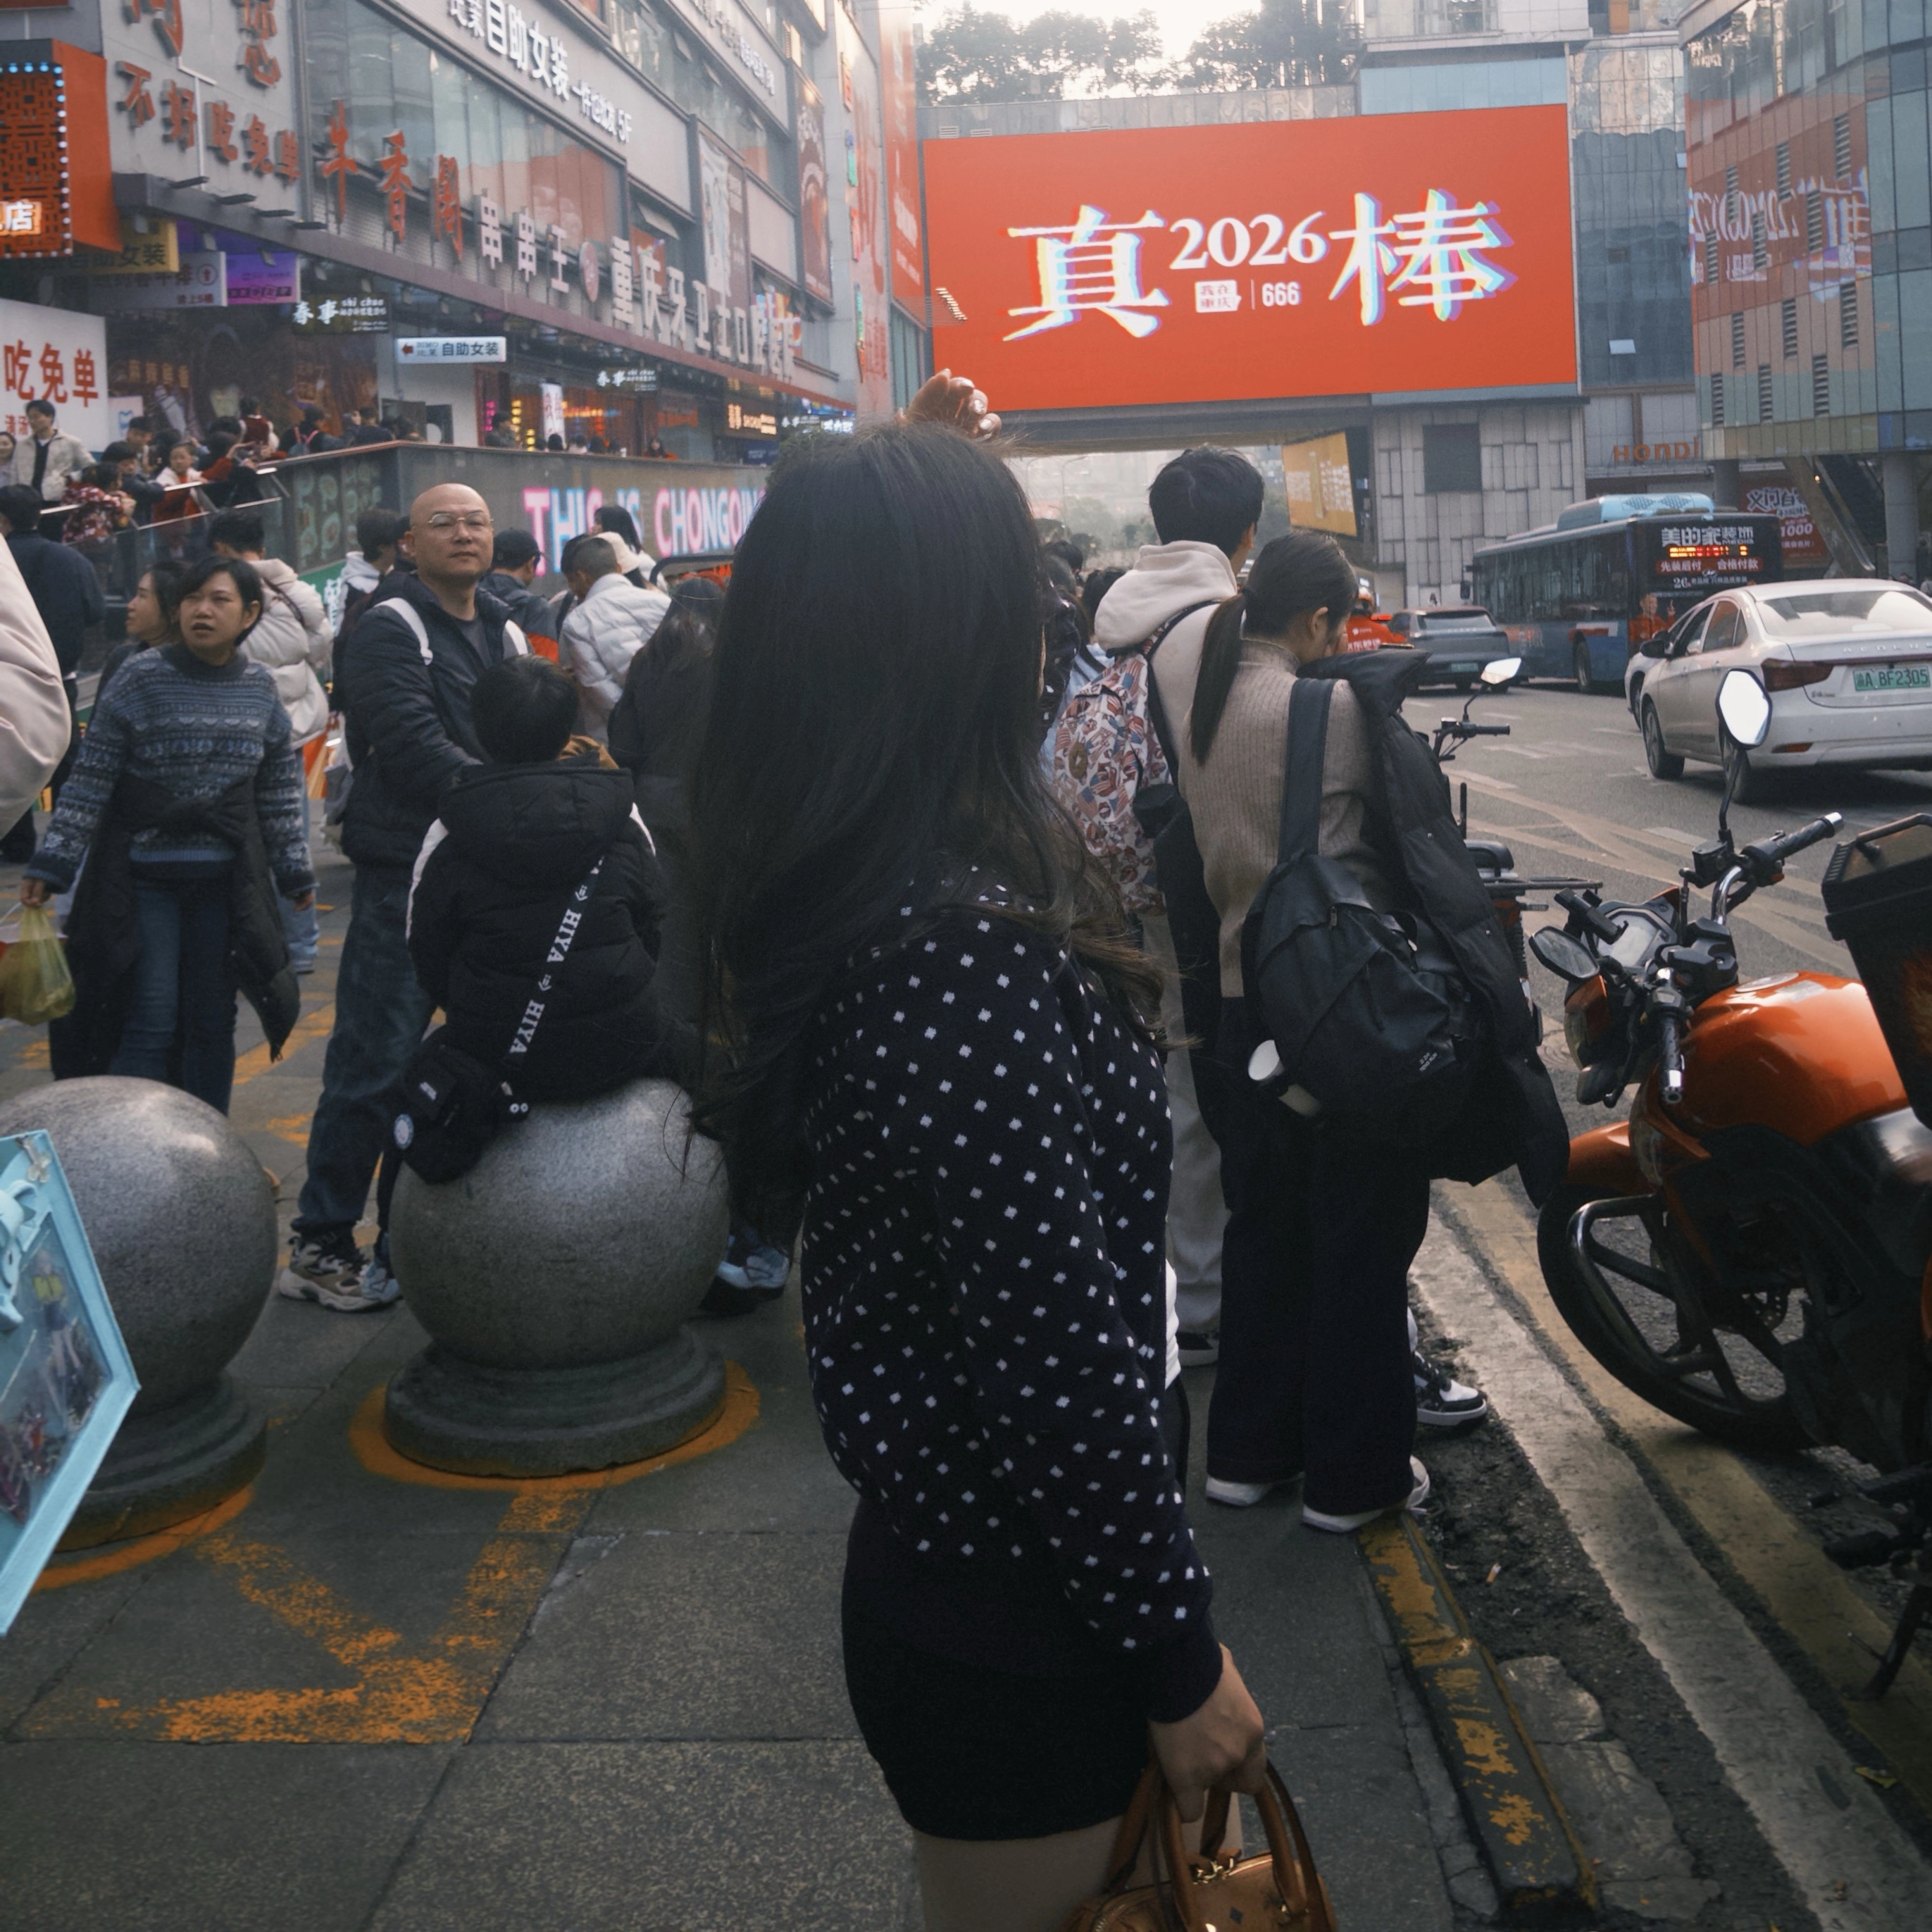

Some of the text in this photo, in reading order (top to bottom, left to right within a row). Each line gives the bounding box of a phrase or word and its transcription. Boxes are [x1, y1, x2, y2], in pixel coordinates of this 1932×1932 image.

[116, 61, 302, 185] 不好吃免单
[0, 200, 34, 231] 店
[480, 189, 569, 293] 串串王
[995, 204, 1170, 342] 真
[1168, 211, 1330, 270] 2026
[1328, 188, 1519, 327] 棒
[1262, 282, 1301, 306] 666
[4, 339, 99, 408] 吃免单
[442, 342, 499, 356] 自助女装
[654, 487, 767, 557] CHONGQIN
[1780, 523, 1813, 537] 1000
[547, 909, 582, 962] HIYA
[509, 999, 545, 1053] HIYA
